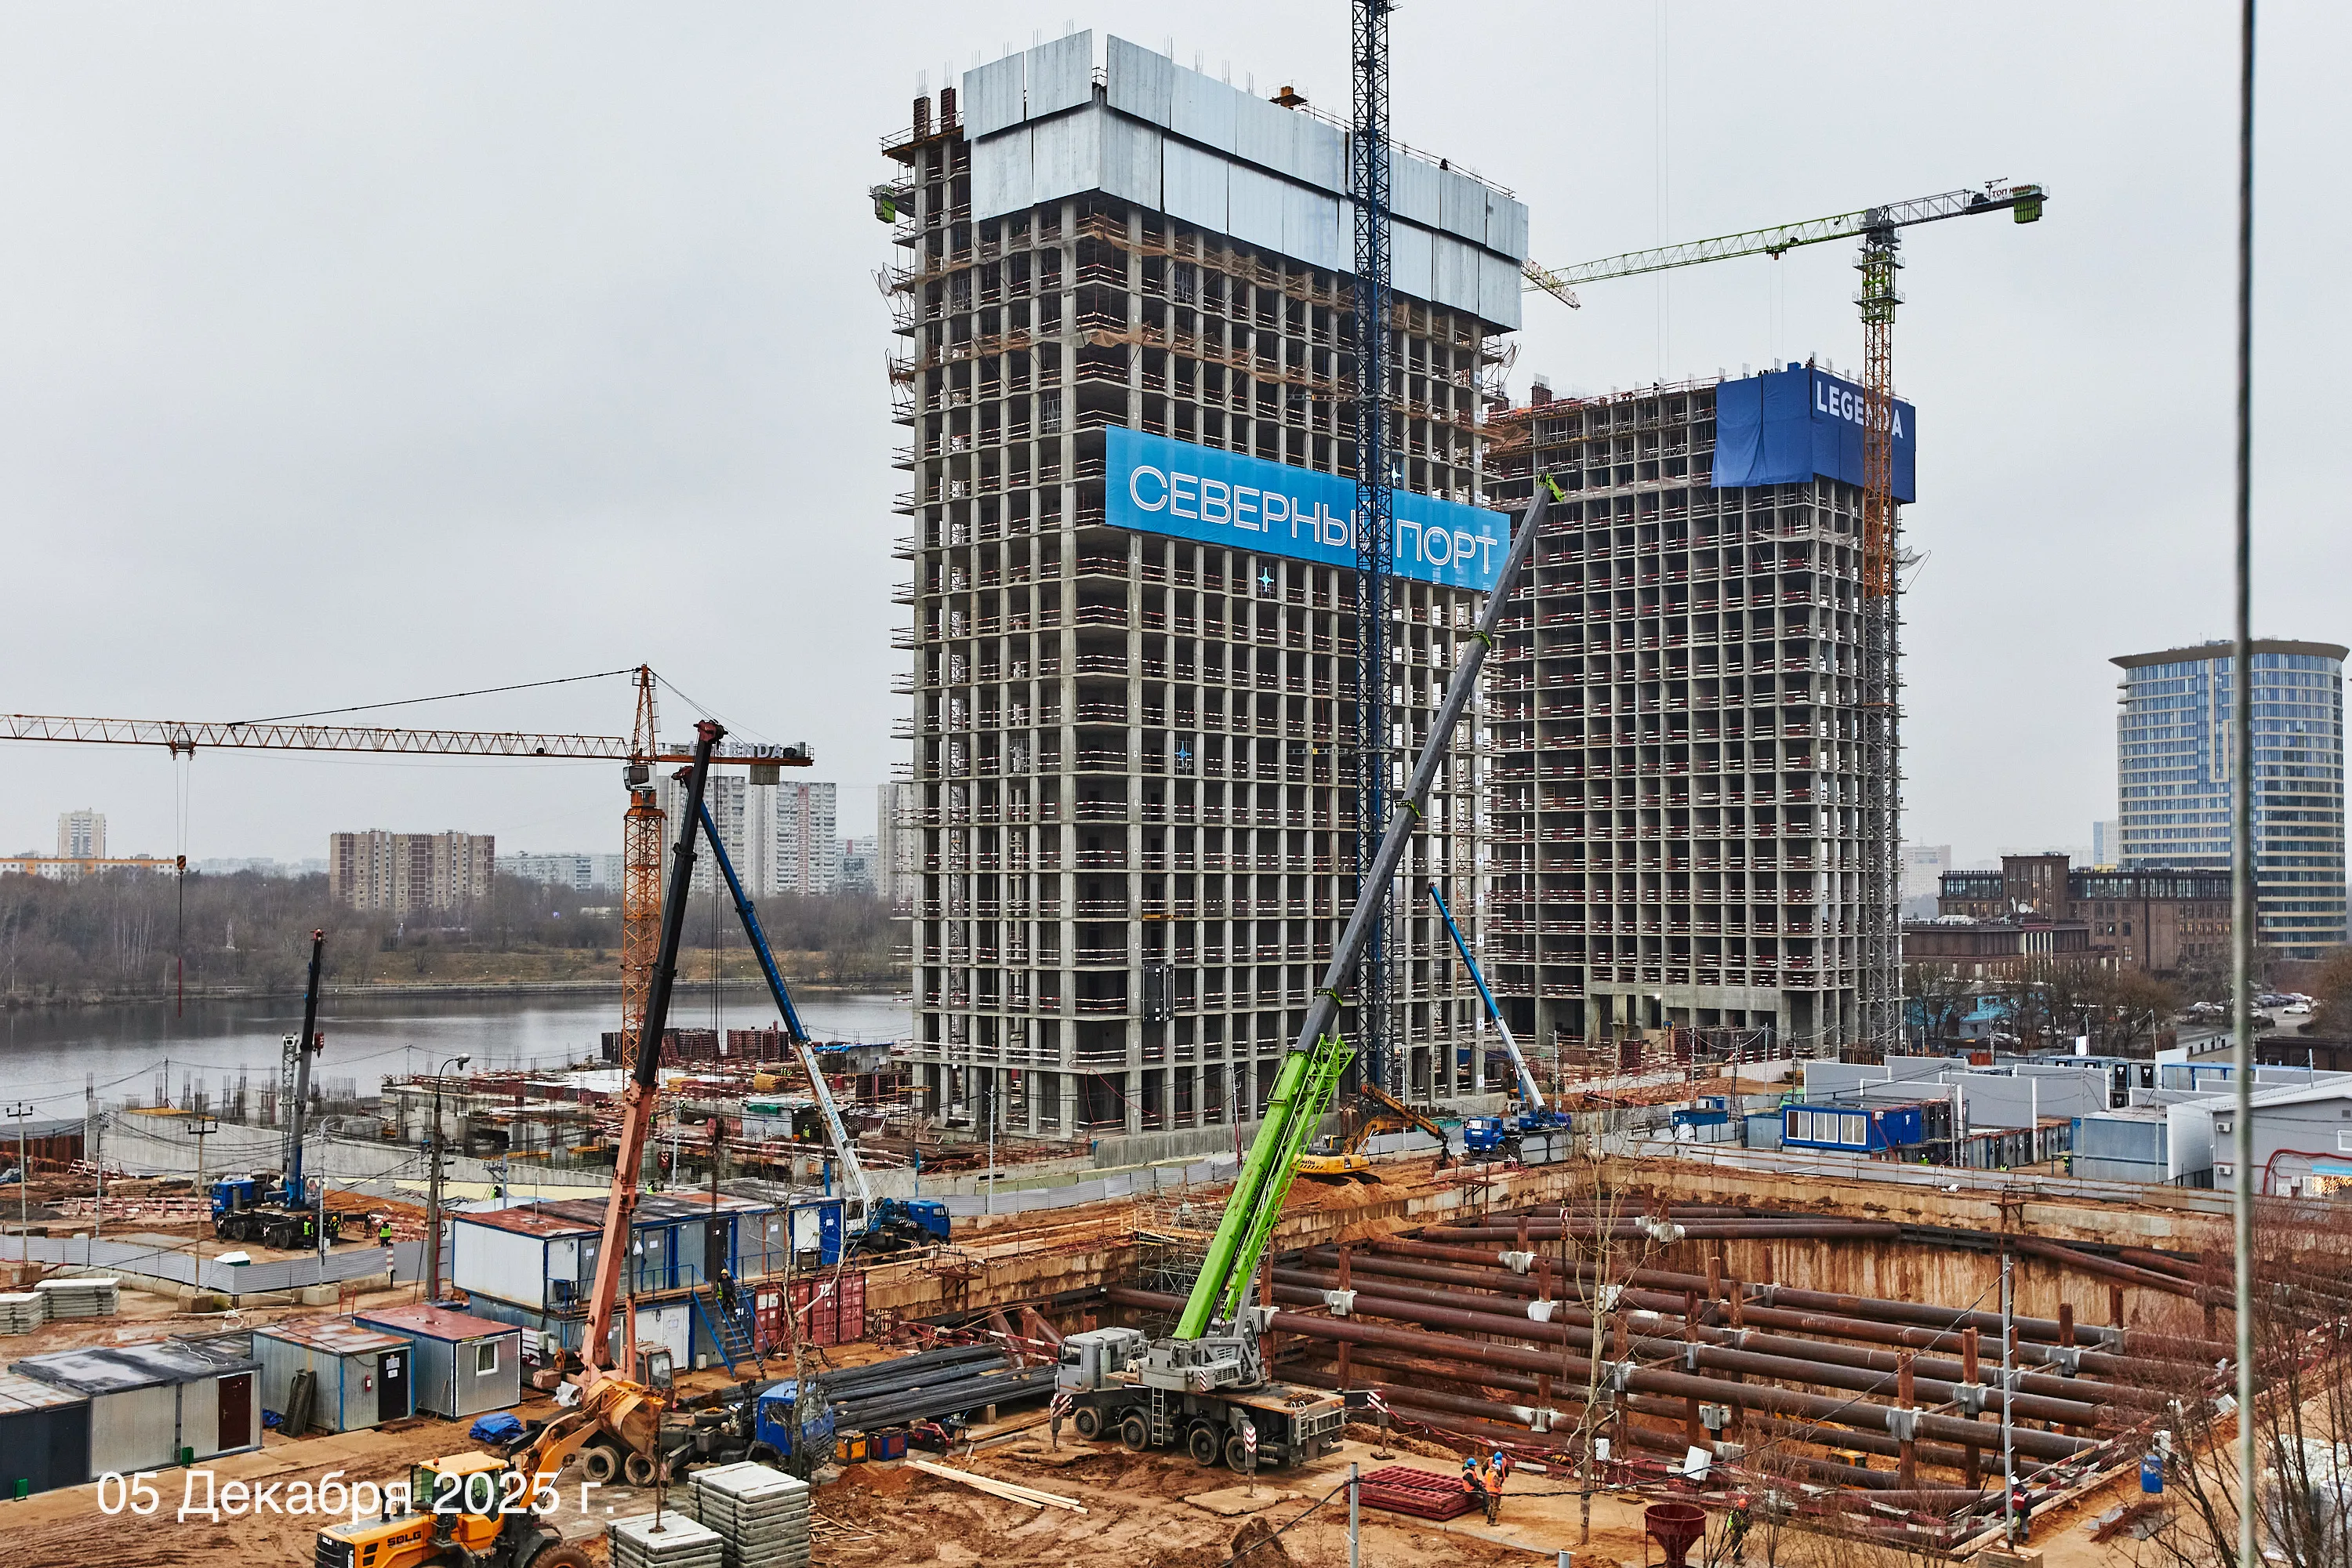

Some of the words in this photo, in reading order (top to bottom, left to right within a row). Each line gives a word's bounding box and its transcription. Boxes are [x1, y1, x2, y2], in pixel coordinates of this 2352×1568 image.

[1396, 518, 1497, 575] ПОРТ
[689, 740, 783, 759] LGENDA
[1246, 1167, 1267, 1213] ZOMLION
[387, 1530, 422, 1547] SDLG
